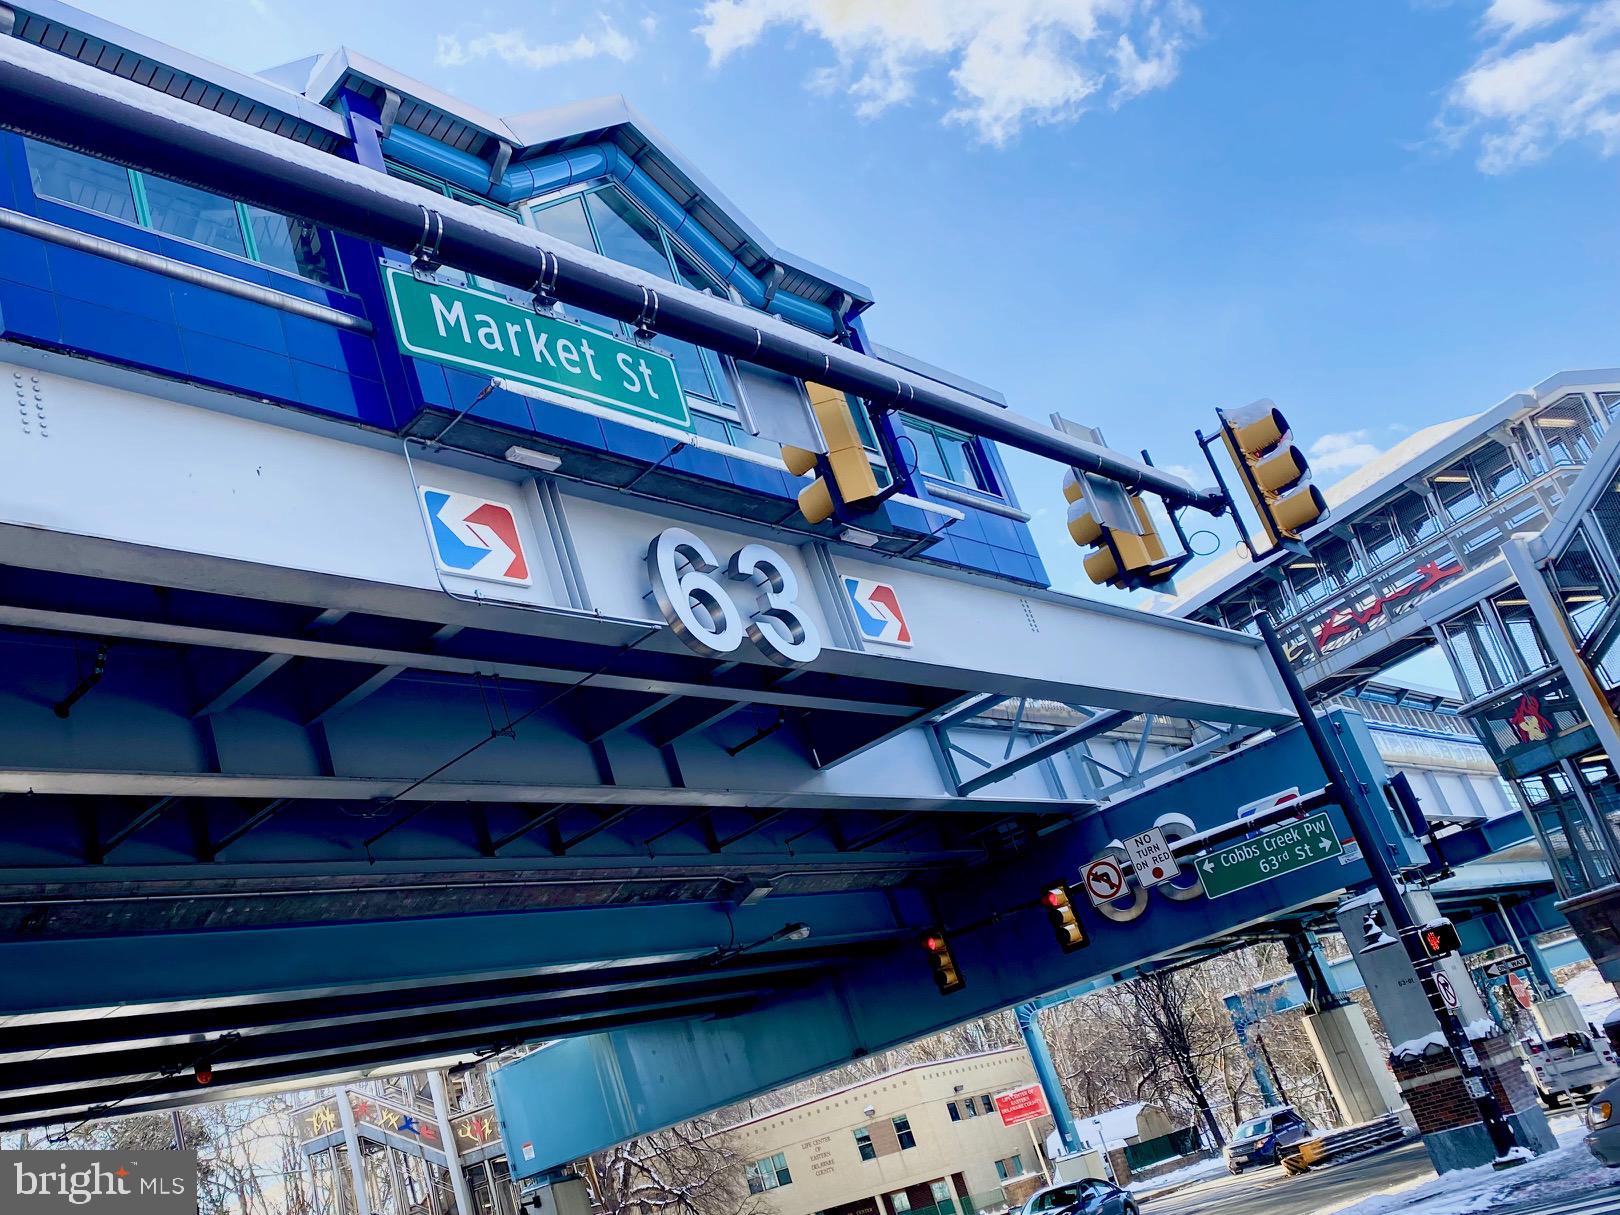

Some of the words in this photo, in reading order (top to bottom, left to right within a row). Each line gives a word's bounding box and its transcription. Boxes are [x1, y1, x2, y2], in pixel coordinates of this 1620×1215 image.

[429, 293, 602, 382] Market
[616, 352, 660, 400] St
[648, 527, 822, 666] 63
[1134, 834, 1152, 848] NO
[1136, 843, 1160, 859] TURN
[1220, 843, 1260, 867] Cobbs
[1263, 827, 1302, 852] Creek
[1136, 860, 1150, 871] ON
[1151, 851, 1170, 865] RED
[1259, 850, 1290, 873] 63rd
[1294, 843, 1314, 860] St
[1511, 958, 1525, 968] WAY
[801, 1141, 812, 1150] LIFE
[812, 1135, 831, 1146] CENTER
